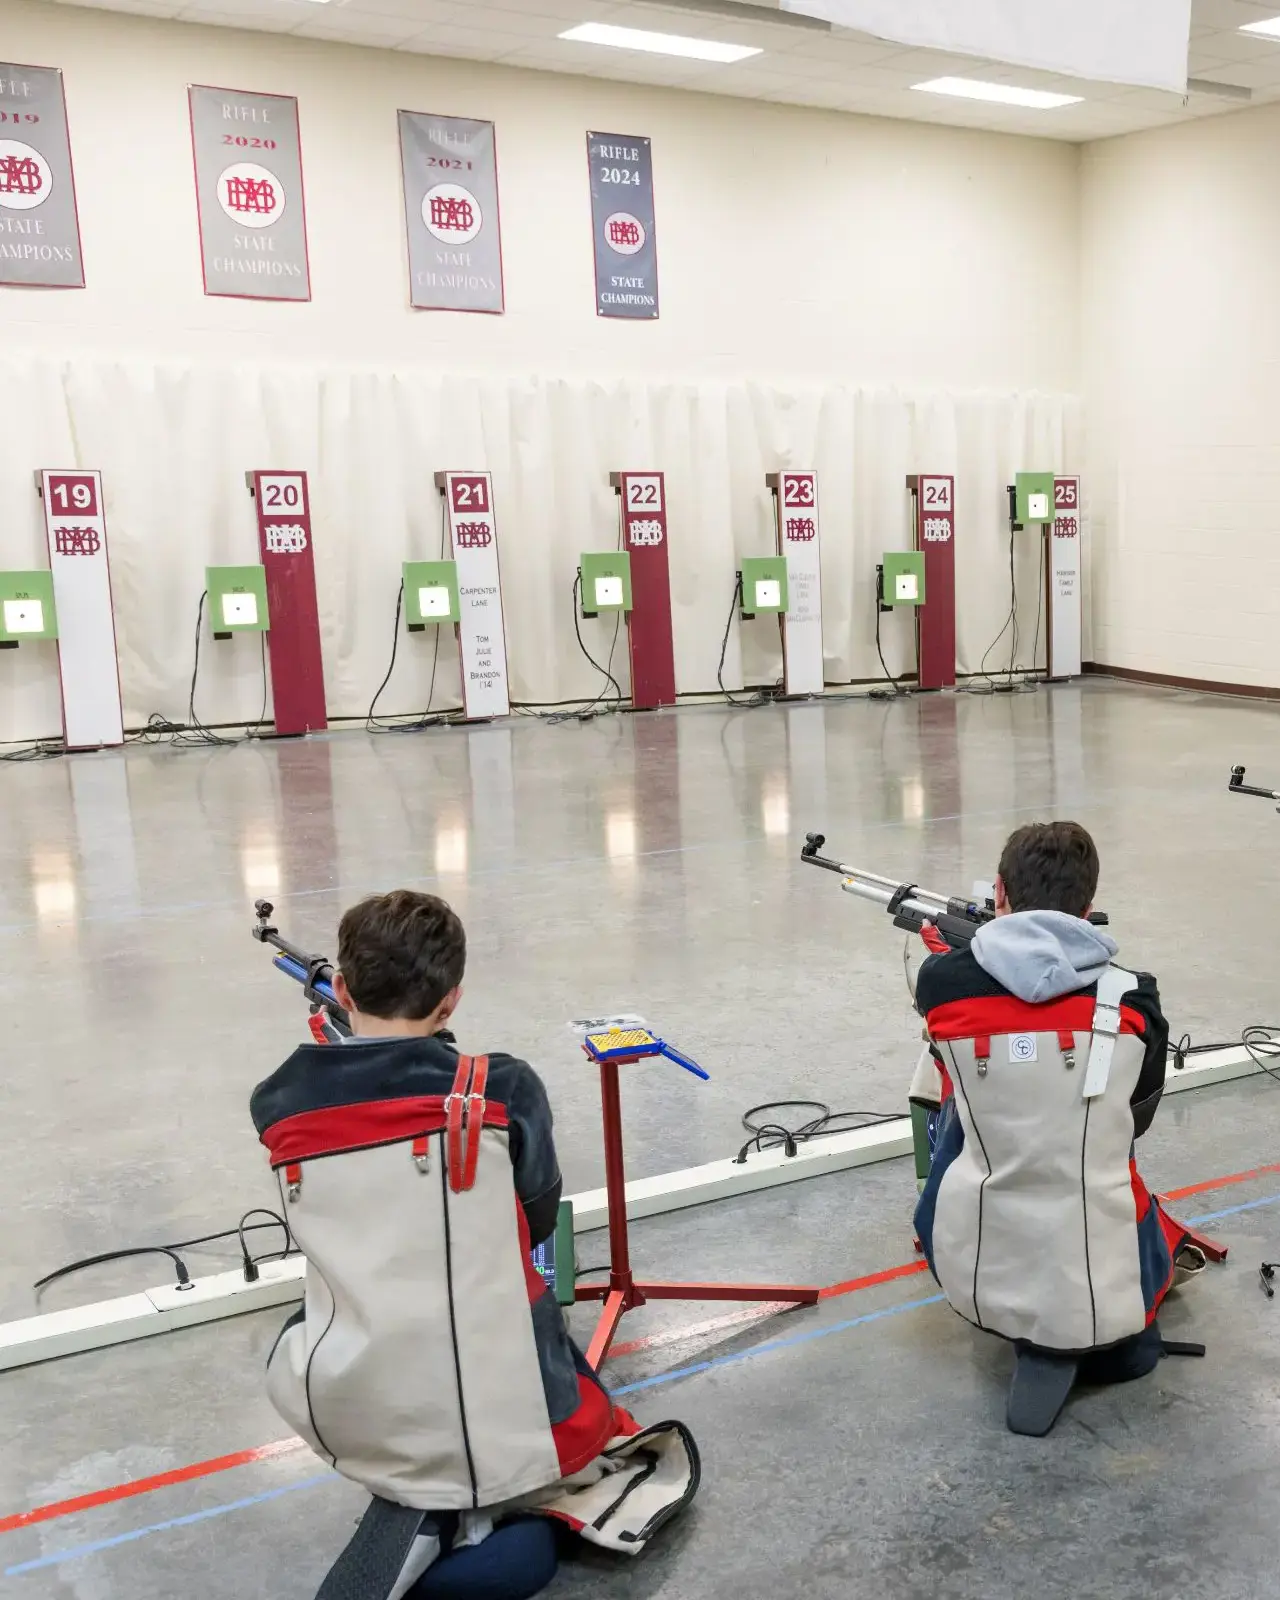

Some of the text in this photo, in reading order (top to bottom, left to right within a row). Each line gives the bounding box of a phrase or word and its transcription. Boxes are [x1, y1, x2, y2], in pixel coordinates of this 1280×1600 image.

[222, 103, 271, 124] RIFLE
[222, 134, 277, 150] 2020
[428, 127, 471, 146] RIFLE
[600, 145, 639, 161] RIFLE
[426, 157, 473, 171] 2021
[600, 167, 641, 186] 2024
[233, 234, 277, 252] STATE
[213, 257, 301, 277] CHAMPIONS
[435, 252, 473, 267] STATE
[417, 271, 496, 291] CHAMPIONS
[611, 275, 645, 289] STATE
[601, 292, 655, 306] CHAMPIONS
[54, 483, 92, 508] 19
[266, 484, 298, 506] 20
[456, 483, 484, 505] 21
[630, 484, 657, 504] 22
[785, 479, 814, 503] 23
[926, 486, 948, 504] 24
[1055, 485, 1075, 503] 25
[460, 587, 497, 596] CARPENTER
[470, 671, 501, 680] BRANDON
